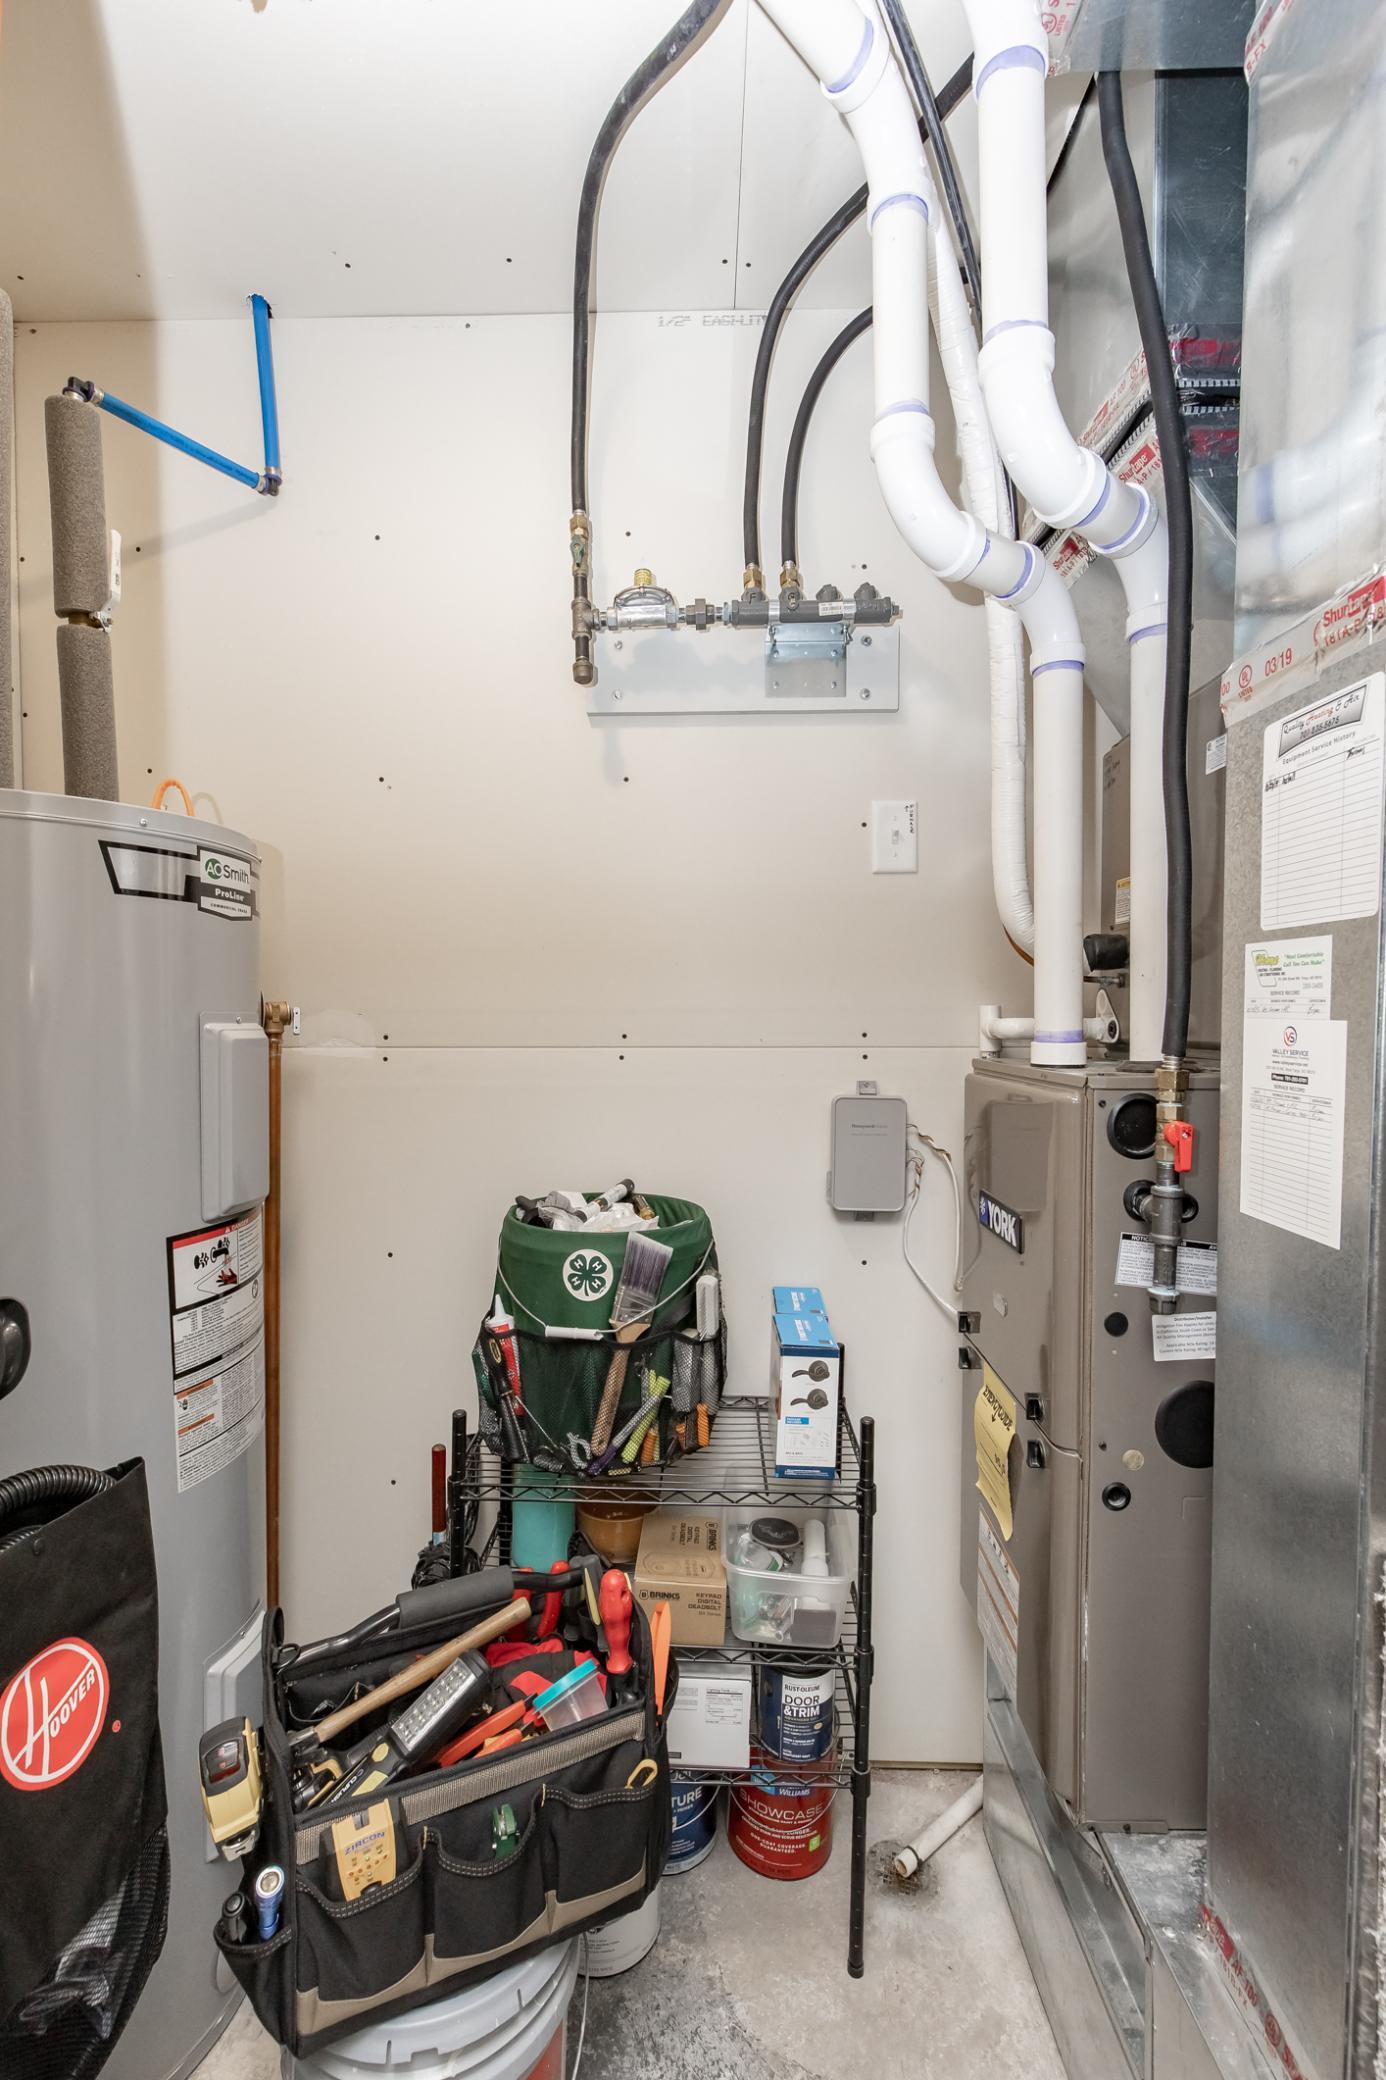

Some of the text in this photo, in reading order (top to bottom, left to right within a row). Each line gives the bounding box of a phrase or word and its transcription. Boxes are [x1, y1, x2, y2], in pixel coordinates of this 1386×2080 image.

[1282, 748, 1311, 765] Equipment
[1311, 741, 1332, 753] Service
[1333, 730, 1356, 745] History
[223, 864, 250, 884] Smith
[988, 1200, 1017, 1248] YORK
[650, 1591, 680, 1600] BRINKS
[784, 1684, 820, 1692] RUST-OLEUM
[785, 1694, 820, 1706] DOOR
[783, 1705, 820, 1718] &TRIM
[740, 1787, 823, 1820] SHOWCASE
[345, 1831, 386, 1856] ZIRCON
